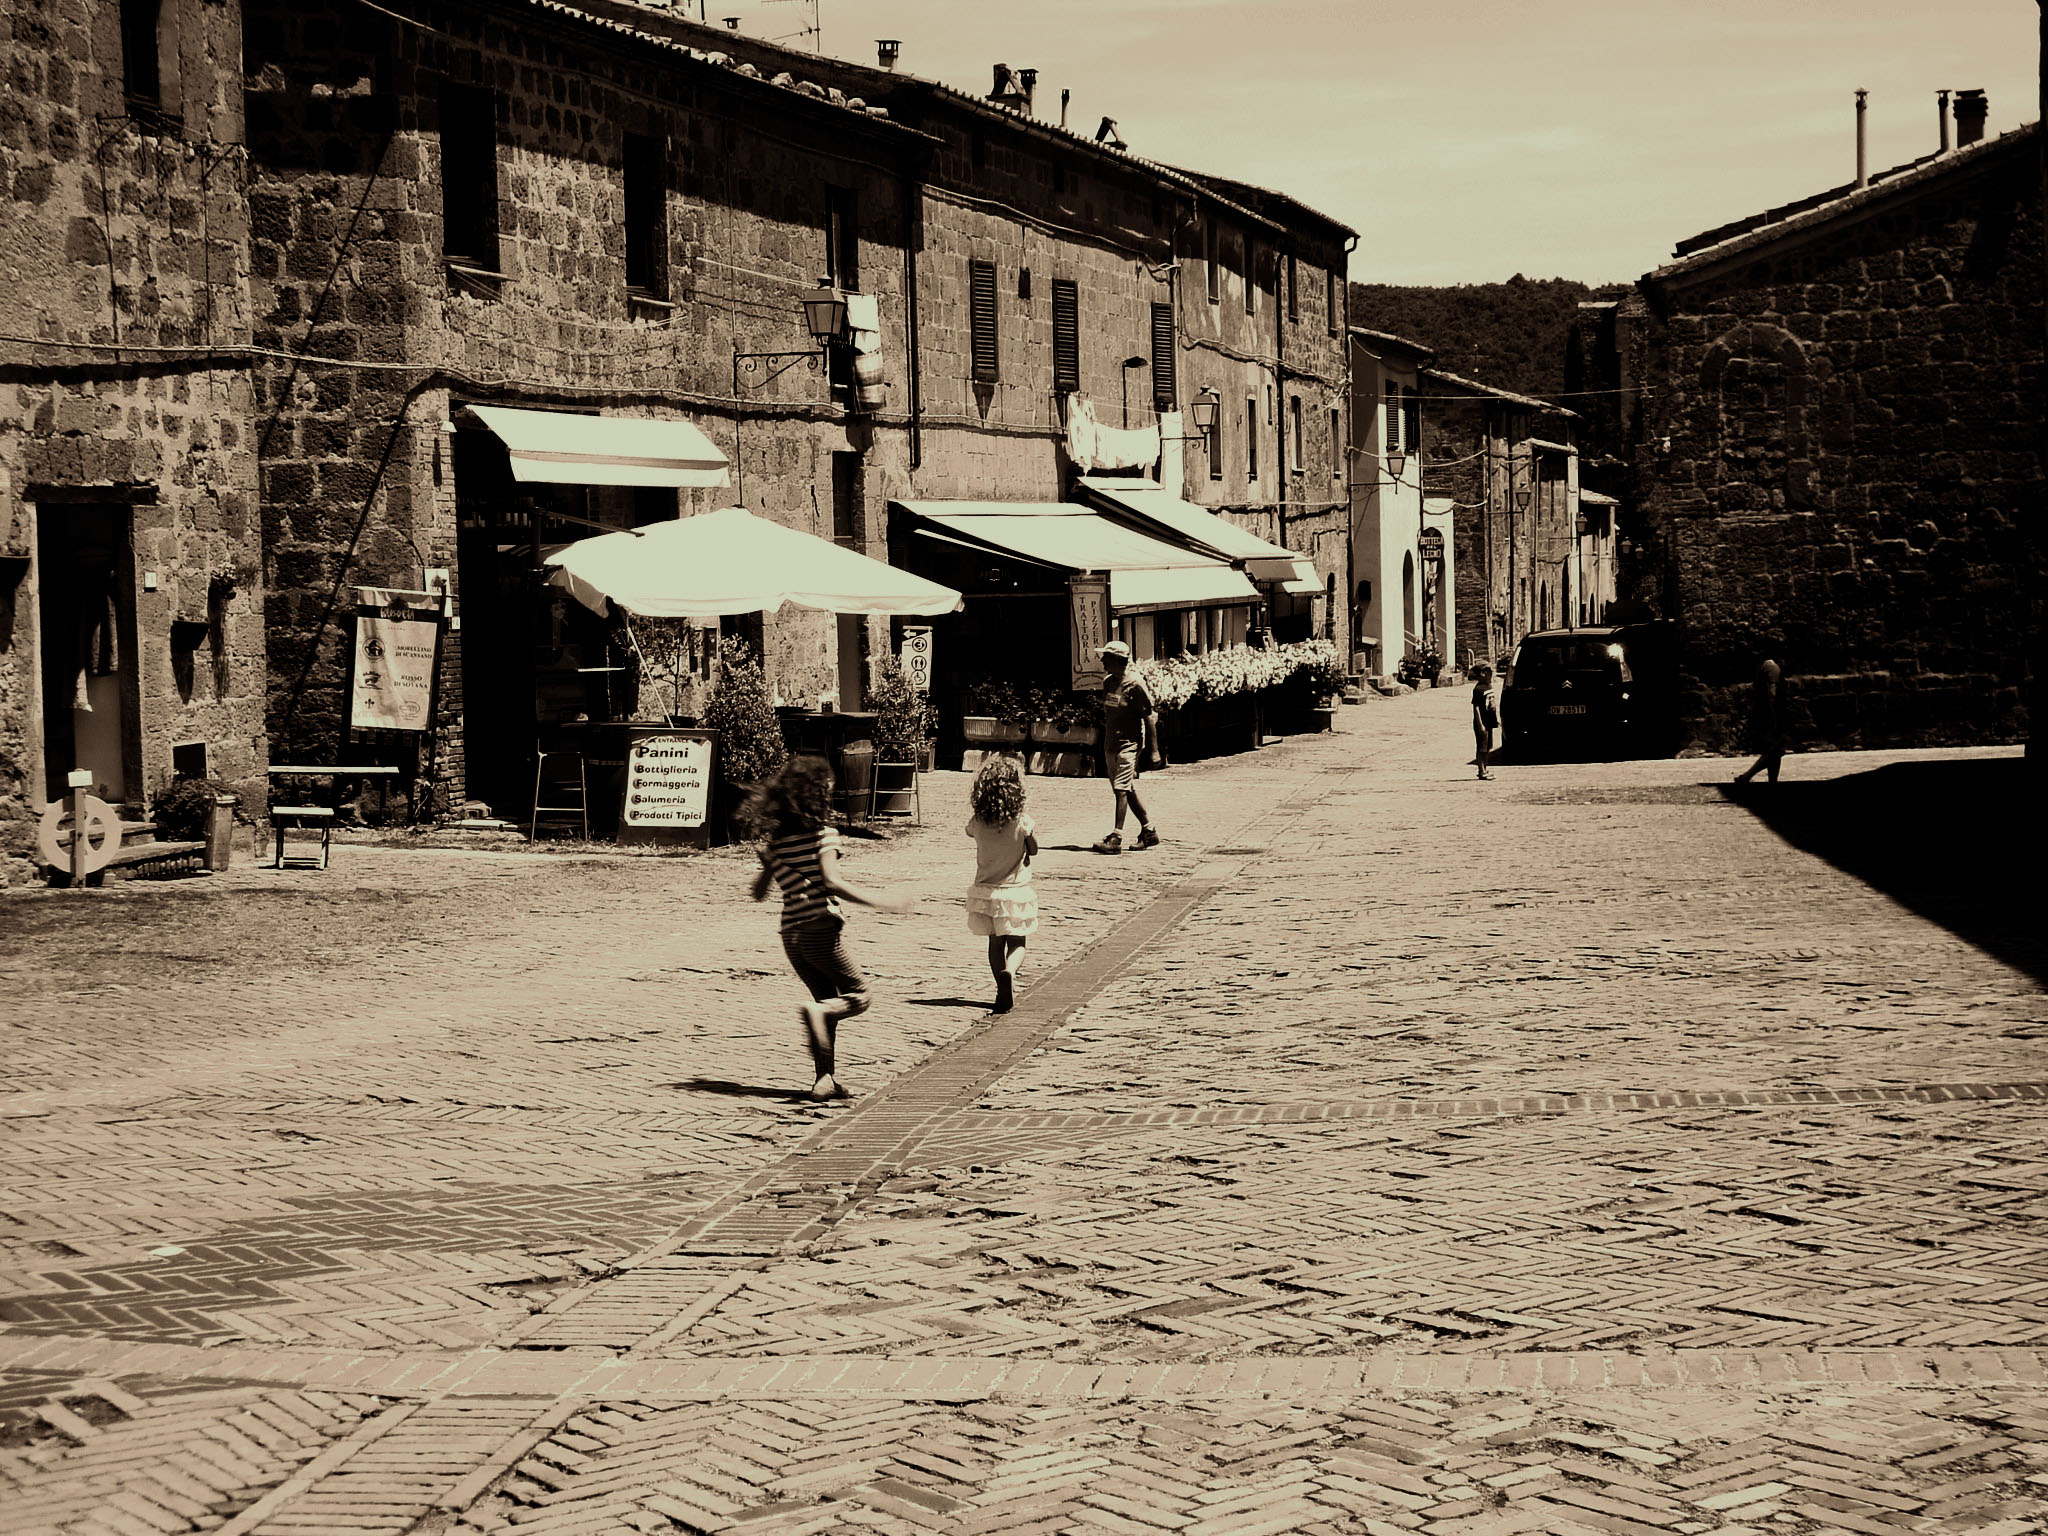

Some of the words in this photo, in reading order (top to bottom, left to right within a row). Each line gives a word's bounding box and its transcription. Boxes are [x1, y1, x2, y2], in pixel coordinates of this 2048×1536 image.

[1080, 597, 1090, 663] TRATTORIA
[638, 747, 689, 758] Panini
[637, 765, 698, 775] Bottiglieria
[635, 779, 700, 790] Formaggeria
[633, 795, 686, 804] Salumeria
[632, 811, 673, 820] Prodotti
[676, 812, 702, 821] Tipici
